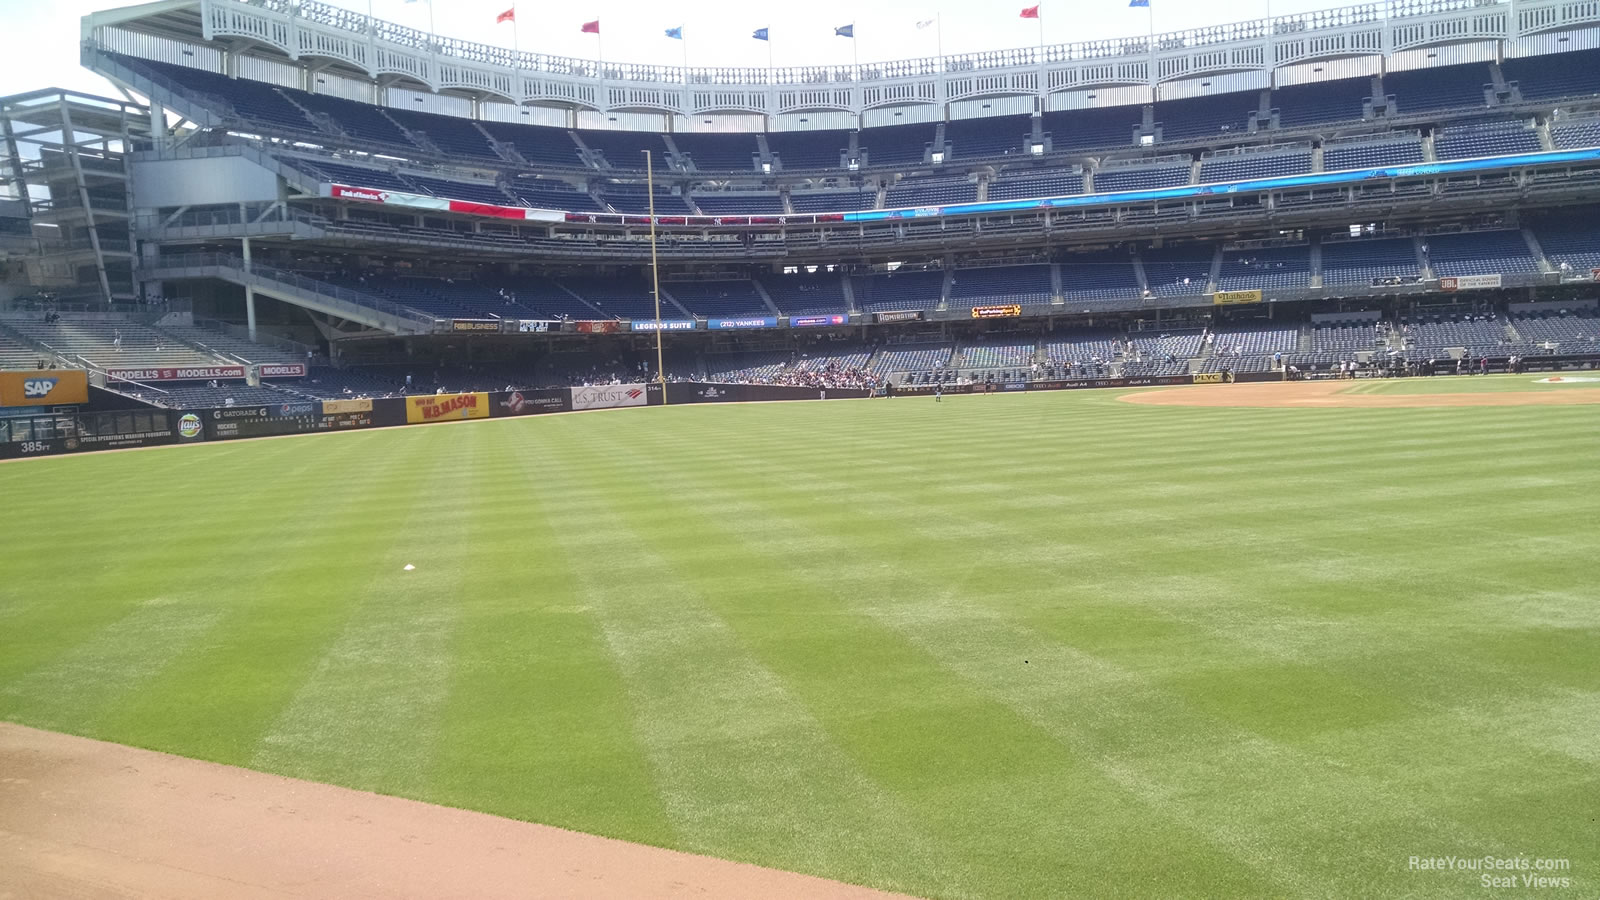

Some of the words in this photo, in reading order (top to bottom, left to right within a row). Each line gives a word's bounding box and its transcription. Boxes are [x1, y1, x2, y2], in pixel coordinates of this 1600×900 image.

[1442, 280, 1456, 288] JBL
[112, 370, 159, 380] MODELL'S
[176, 369, 241, 378] MODELLS.com
[262, 366, 300, 374] MODELL'S
[24, 381, 52, 395] SAP
[574, 394, 590, 404] U.S.
[591, 391, 622, 402] TRUST
[292, 403, 312, 414] pepsi
